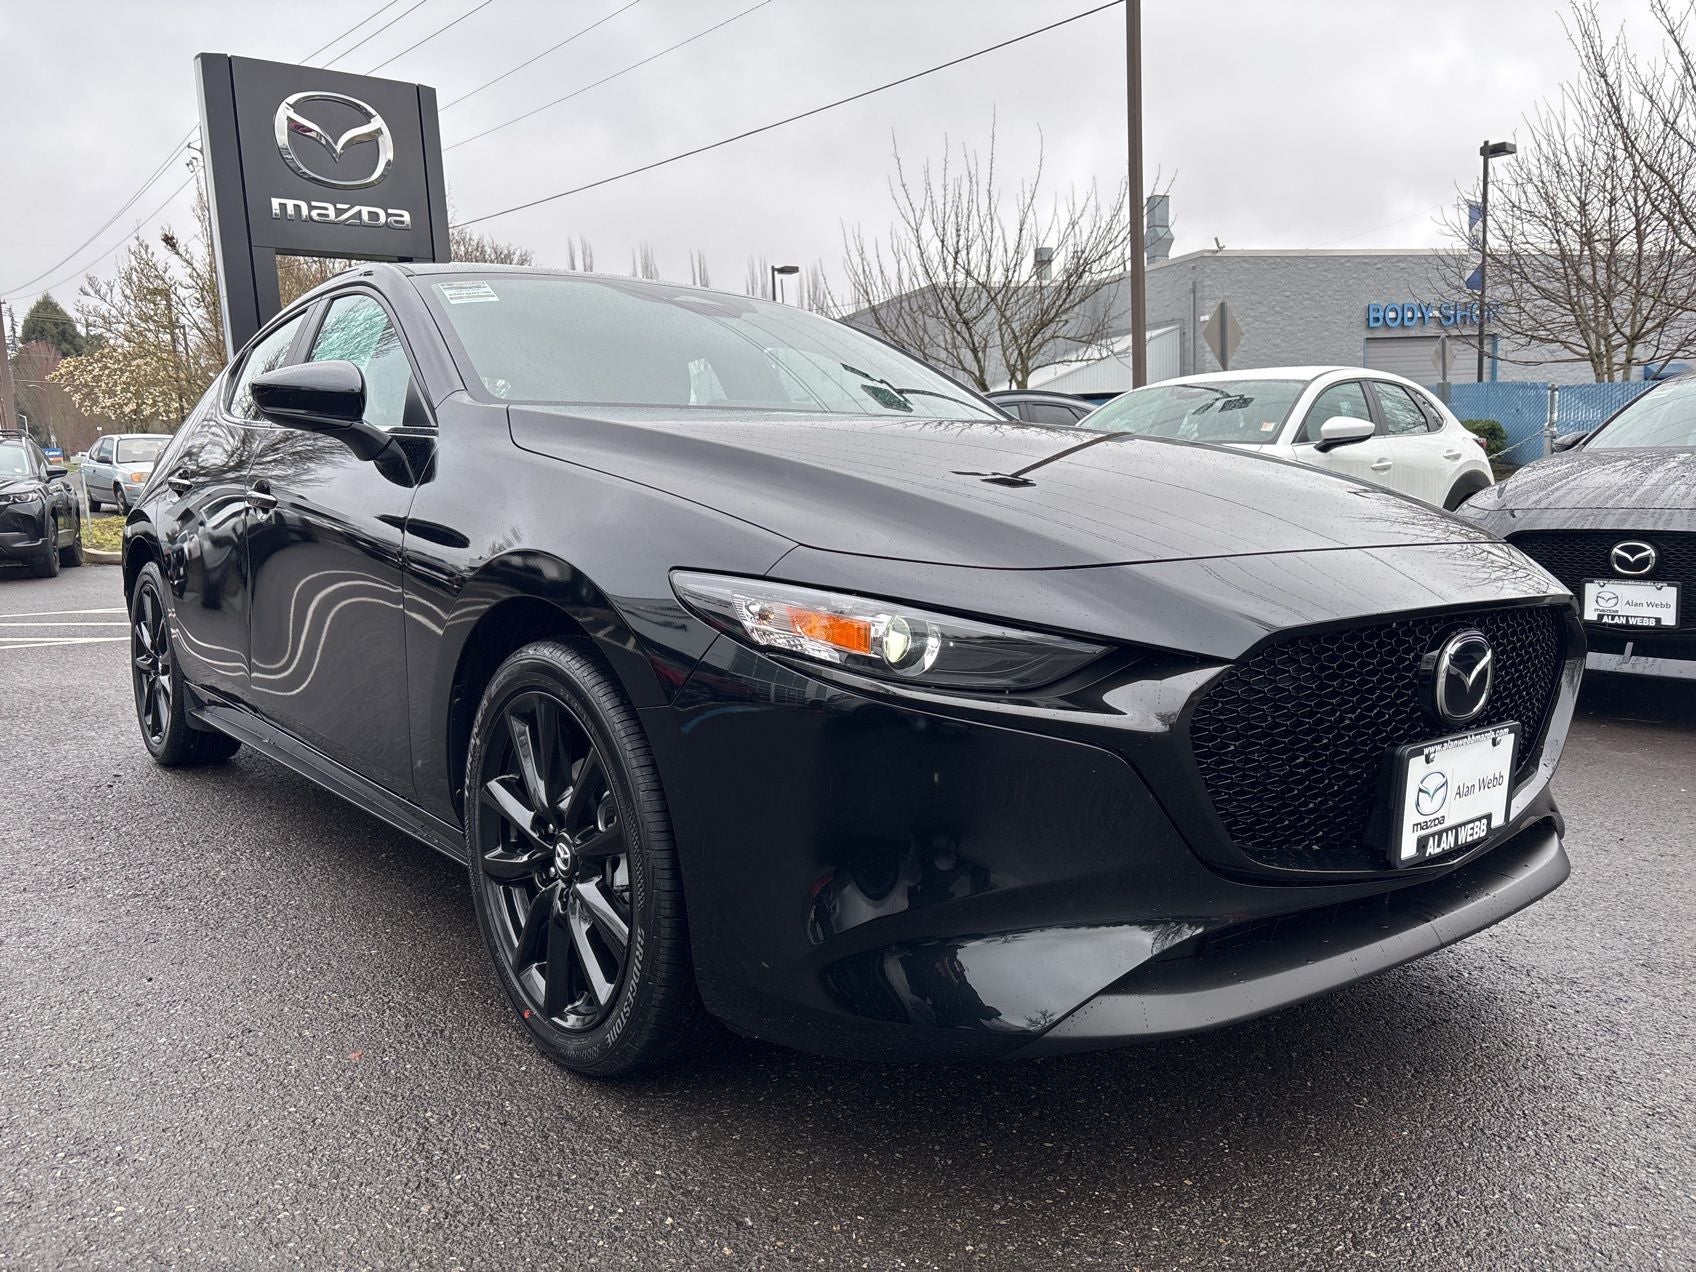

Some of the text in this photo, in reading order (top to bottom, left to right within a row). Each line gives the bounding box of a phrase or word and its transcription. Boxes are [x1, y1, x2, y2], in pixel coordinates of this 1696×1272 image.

[1368, 302, 1432, 328] BODY
[1624, 600, 1671, 609] Alan Webb
[1602, 615, 1656, 626] ALAN WEBB
[1423, 728, 1510, 755] www.alanwebbmazda.com
[1454, 771, 1504, 800] Alan Webb
[1426, 819, 1487, 857] ALAN WEBB
